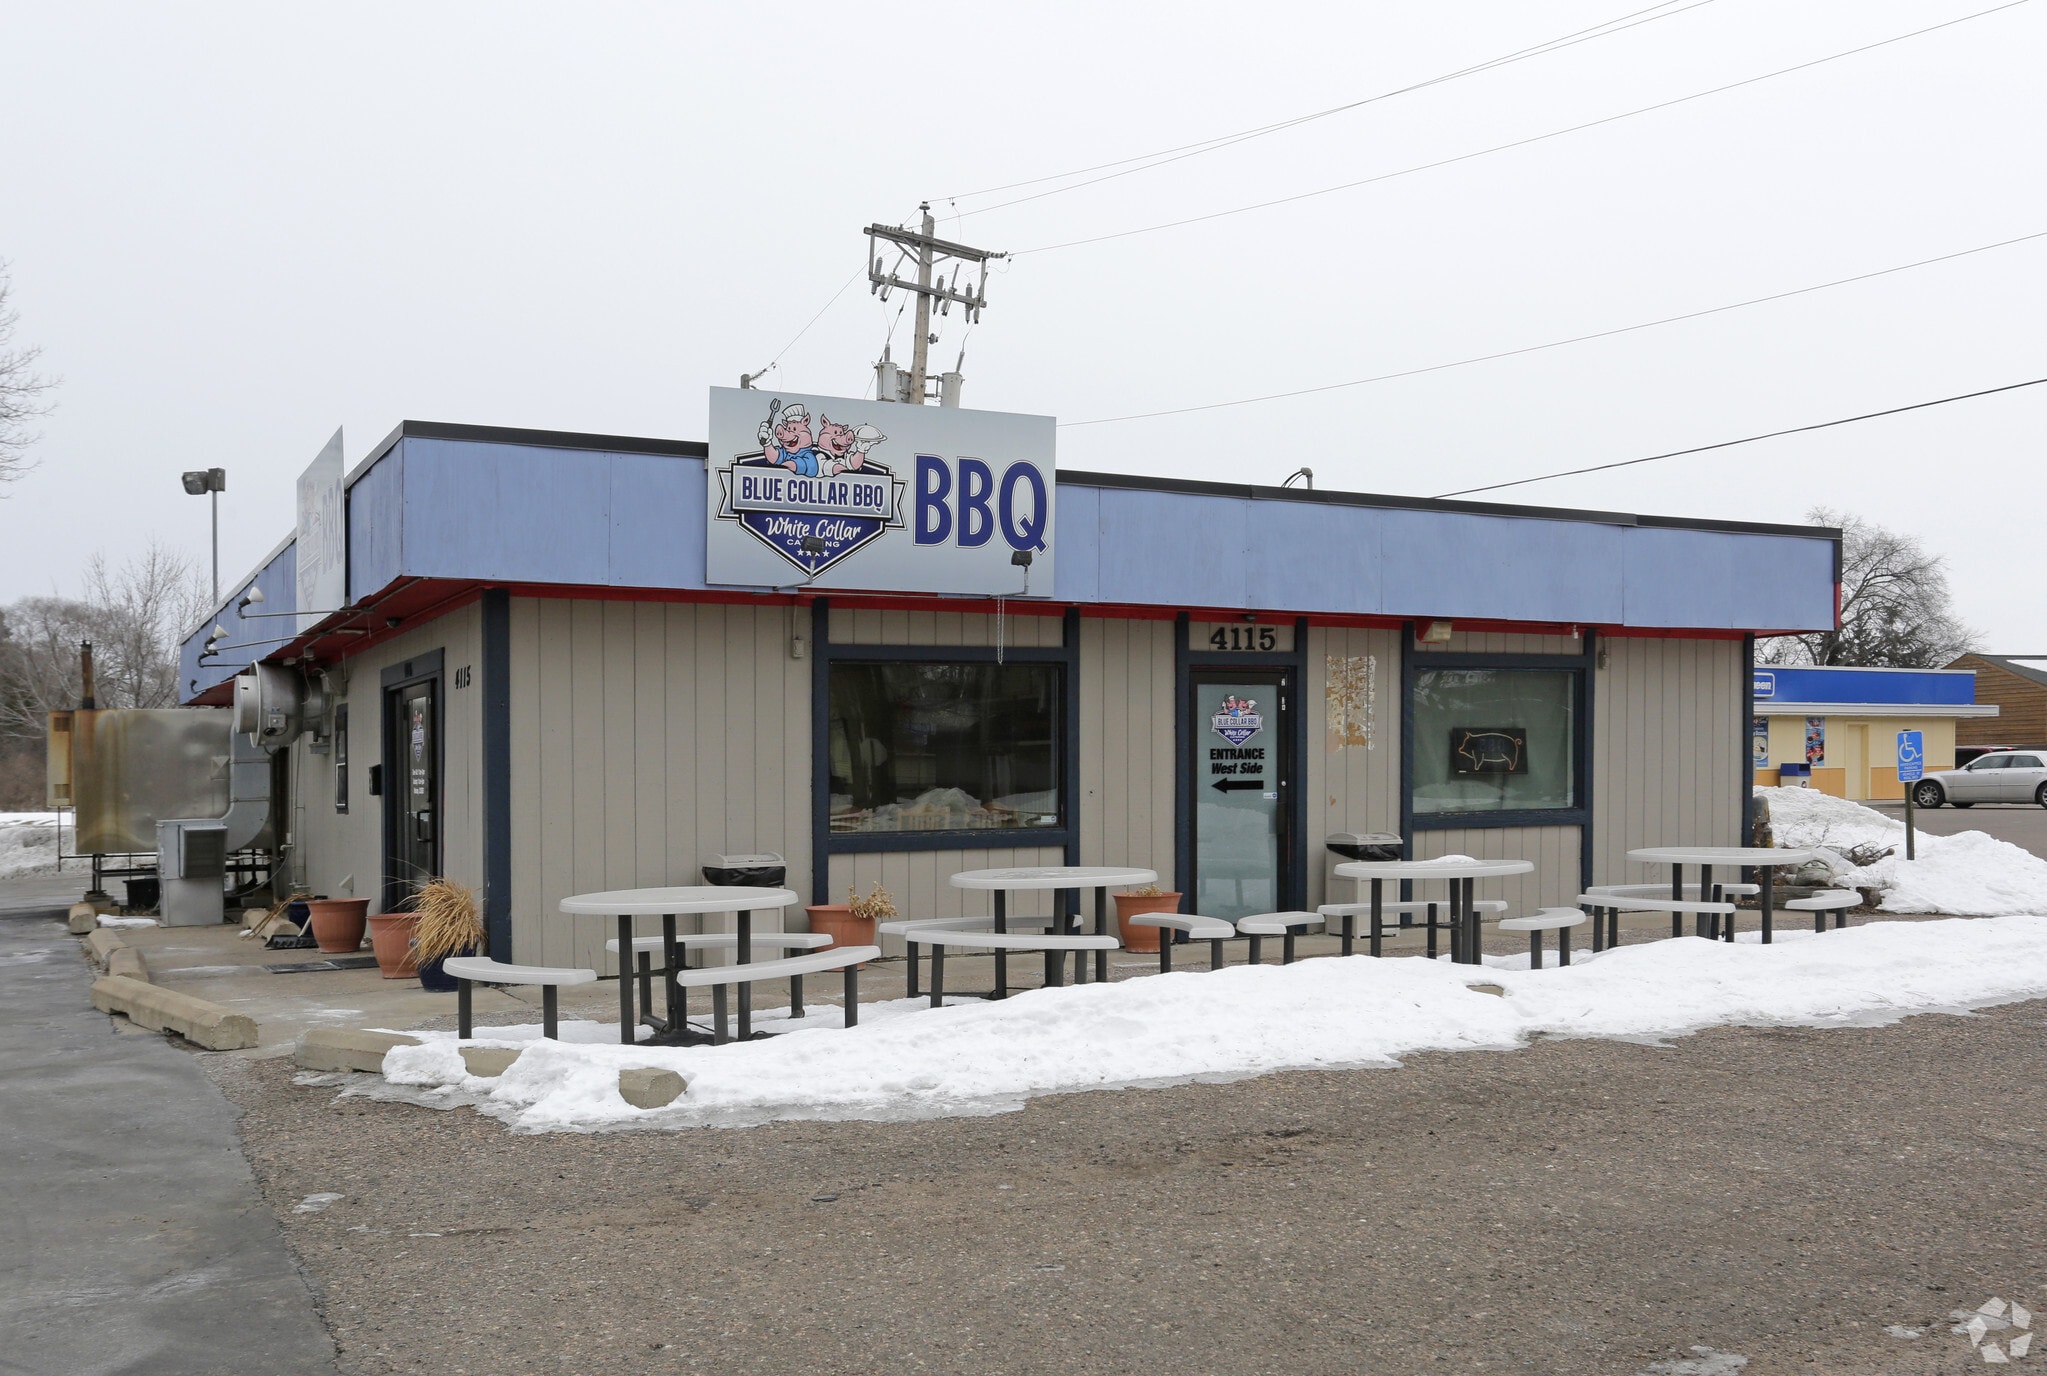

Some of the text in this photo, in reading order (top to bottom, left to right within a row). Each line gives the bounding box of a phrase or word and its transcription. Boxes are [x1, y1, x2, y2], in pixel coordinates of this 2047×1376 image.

[742, 476, 884, 512] BLUE COLLAR BBQ
[914, 453, 1049, 554] BBQ
[765, 516, 862, 541] White Collar
[786, 538, 840, 548] CANG
[1210, 626, 1276, 651] 4115
[455, 664, 471, 690] 4115
[1210, 748, 1265, 760] ENTRANCE
[1211, 762, 1263, 774] West Side
